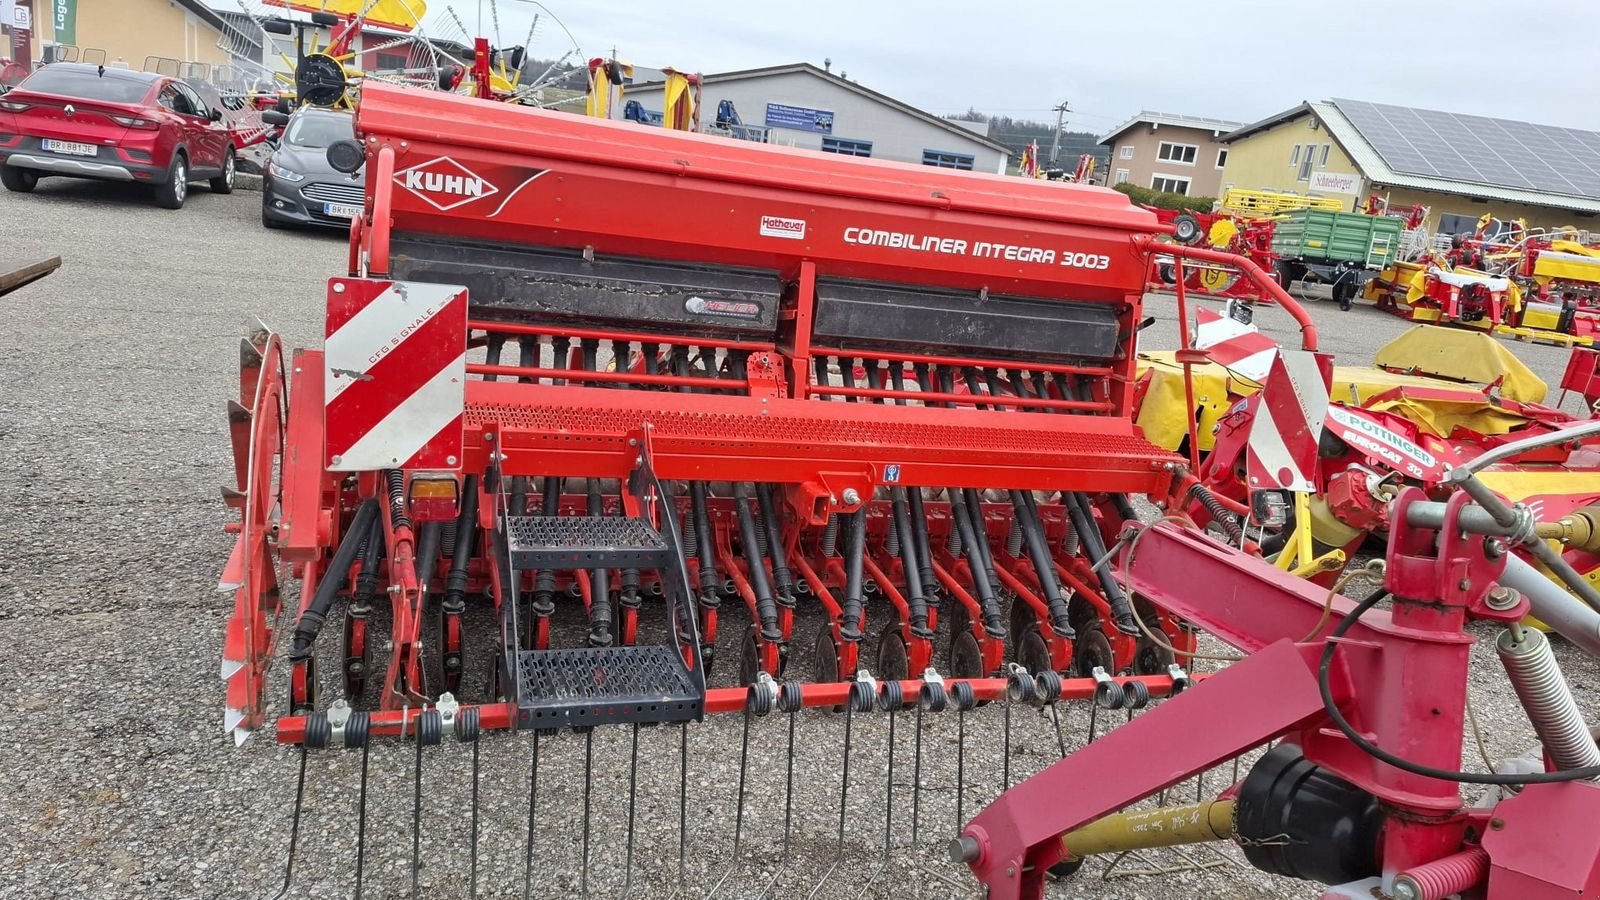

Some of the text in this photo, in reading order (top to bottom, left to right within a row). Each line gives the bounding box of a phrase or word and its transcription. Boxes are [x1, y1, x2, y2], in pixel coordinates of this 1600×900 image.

[406, 169, 483, 197] KUHN
[1315, 174, 1353, 192] Schneeberger
[843, 227, 1111, 271] COMBILINER INTEGRA 3003
[368, 307, 435, 364] CFG SGNALE
[1297, 392, 1311, 420] SGNALE
[1342, 430, 1424, 478] EUROCAT 312
